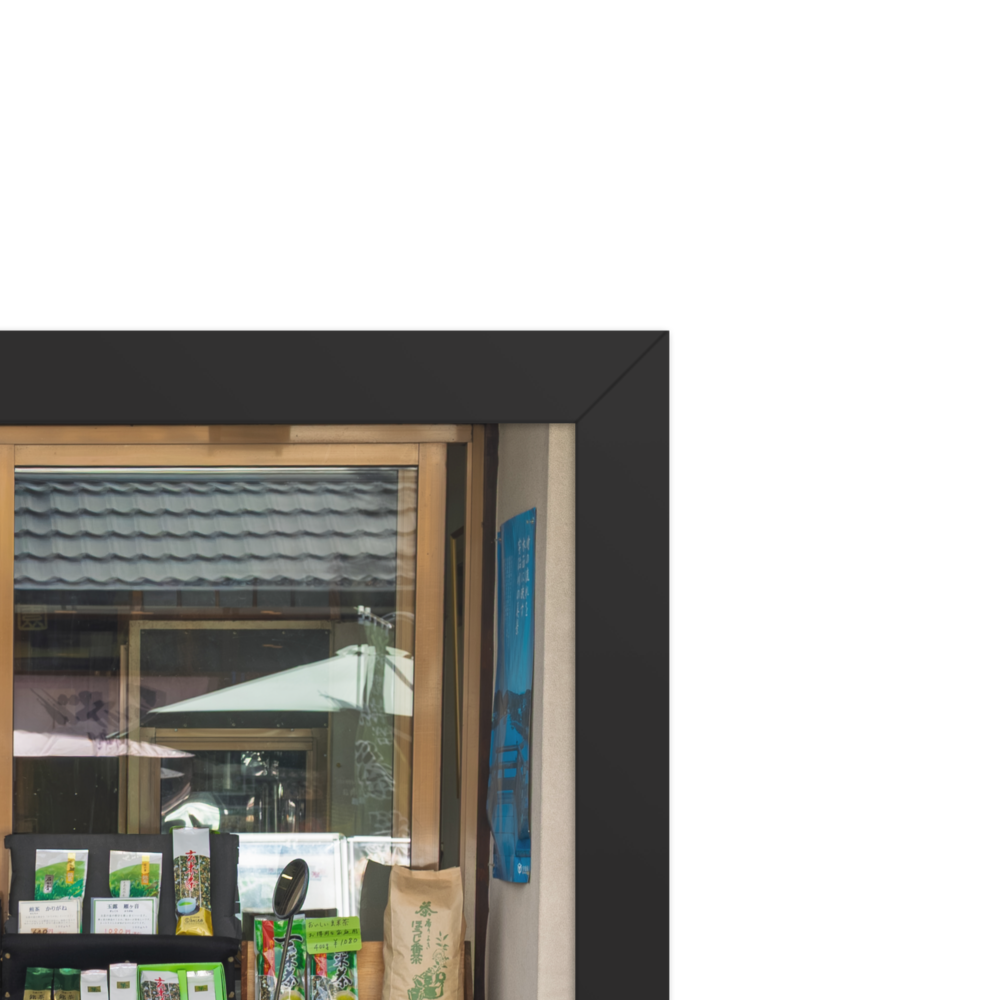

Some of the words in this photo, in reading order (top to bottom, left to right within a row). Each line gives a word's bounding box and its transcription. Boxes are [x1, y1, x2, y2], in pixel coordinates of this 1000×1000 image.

[185, 850, 198, 891] 玄米茶
[415, 901, 438, 917] 茶
[410, 920, 423, 965] ほうじ番茶
[332, 951, 353, 989] 米茶
